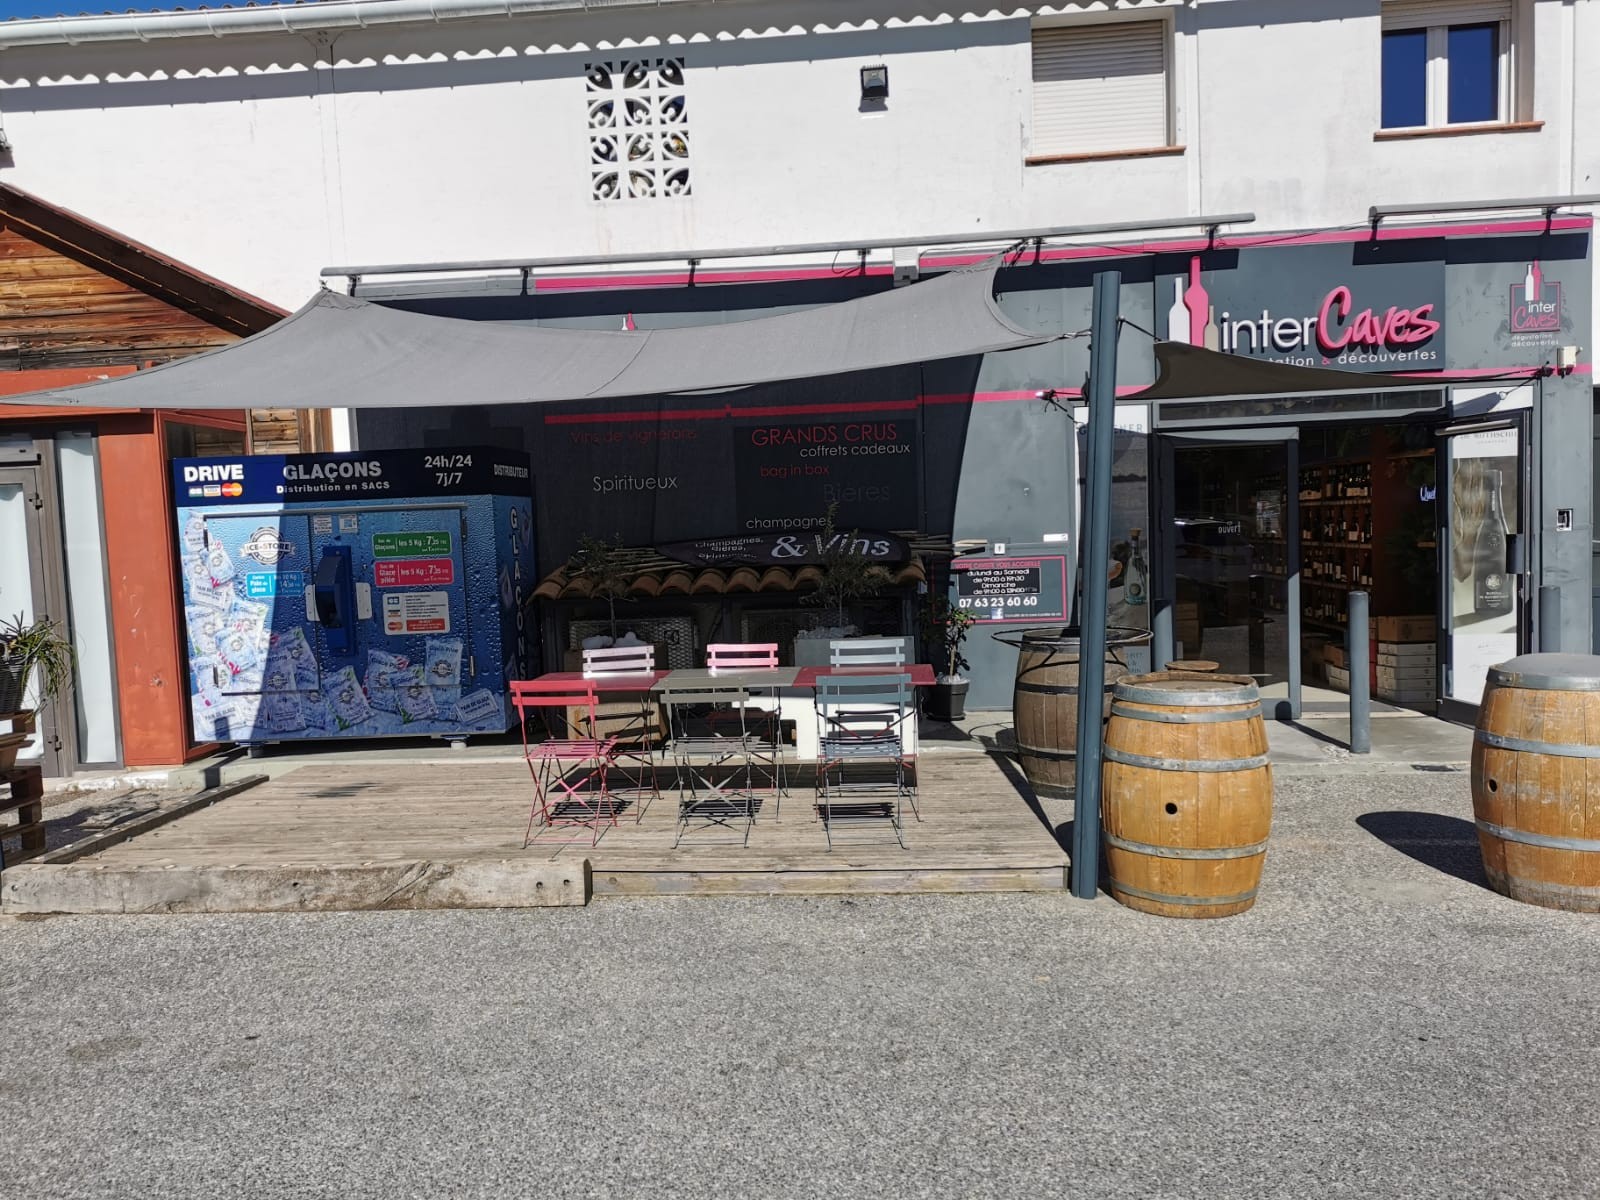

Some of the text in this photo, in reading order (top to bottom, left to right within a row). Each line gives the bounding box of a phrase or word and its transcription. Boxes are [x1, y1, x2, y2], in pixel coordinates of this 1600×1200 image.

[1528, 301, 1557, 313] inter
[1514, 306, 1557, 329] Caves
[1269, 349, 1437, 366] tation & découvertes
[751, 423, 897, 446] GRANDS CRUS
[800, 442, 911, 457] coffrets cadeaux
[424, 454, 473, 468] 24h/24
[184, 464, 245, 482] DRIVE
[283, 460, 383, 483] GLAÇONS
[493, 463, 529, 478] DISTRIBUTEUR
[760, 463, 830, 478] bag in box
[435, 472, 463, 487] 7j/7
[592, 474, 678, 494] Spiritueux
[276, 481, 391, 494] Distribution en SACS
[771, 532, 891, 558] & Vins
[959, 596, 1038, 608] 07 63 23 60 60
